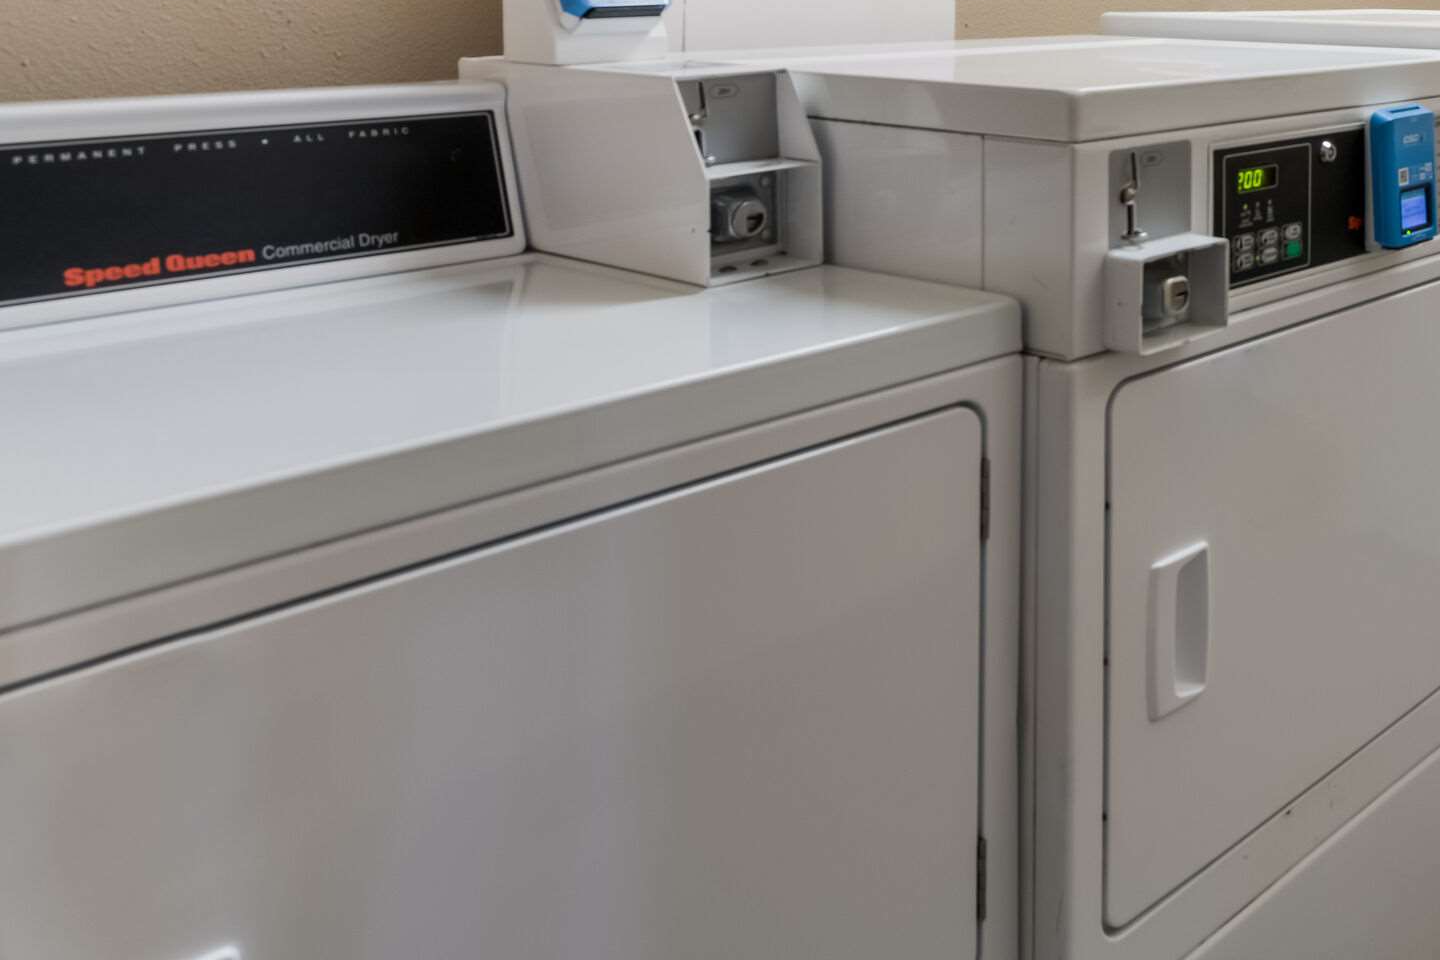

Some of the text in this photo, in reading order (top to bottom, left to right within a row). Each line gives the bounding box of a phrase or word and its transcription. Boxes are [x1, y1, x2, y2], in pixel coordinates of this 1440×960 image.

[11, 126, 411, 165] PERMANENT PRESS ALL FABRIC
[63, 232, 399, 287] Speed Queen Commercial Dryer
